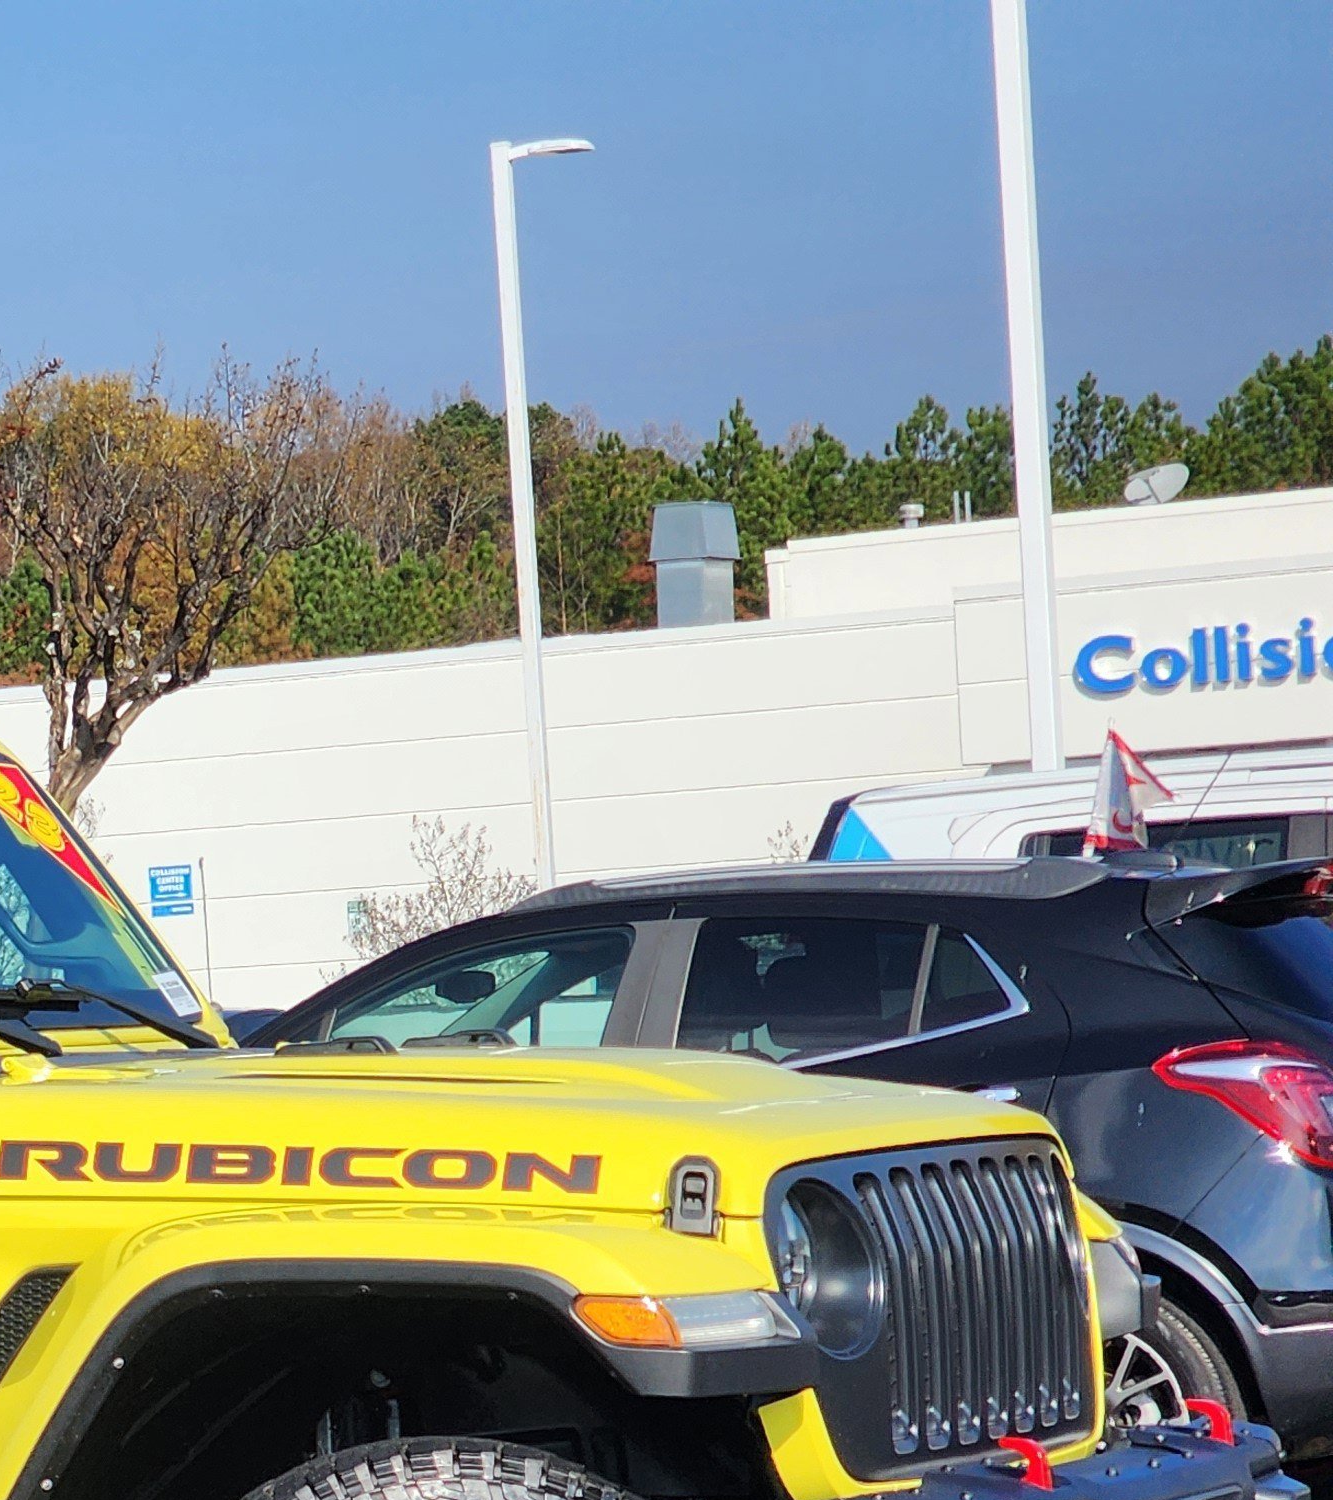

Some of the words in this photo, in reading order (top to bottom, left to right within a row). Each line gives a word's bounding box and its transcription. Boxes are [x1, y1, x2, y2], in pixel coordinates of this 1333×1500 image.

[1074, 616, 1333, 695] Collisi
[150, 867, 190, 878] COLLISION
[158, 883, 185, 893] OFFICE
